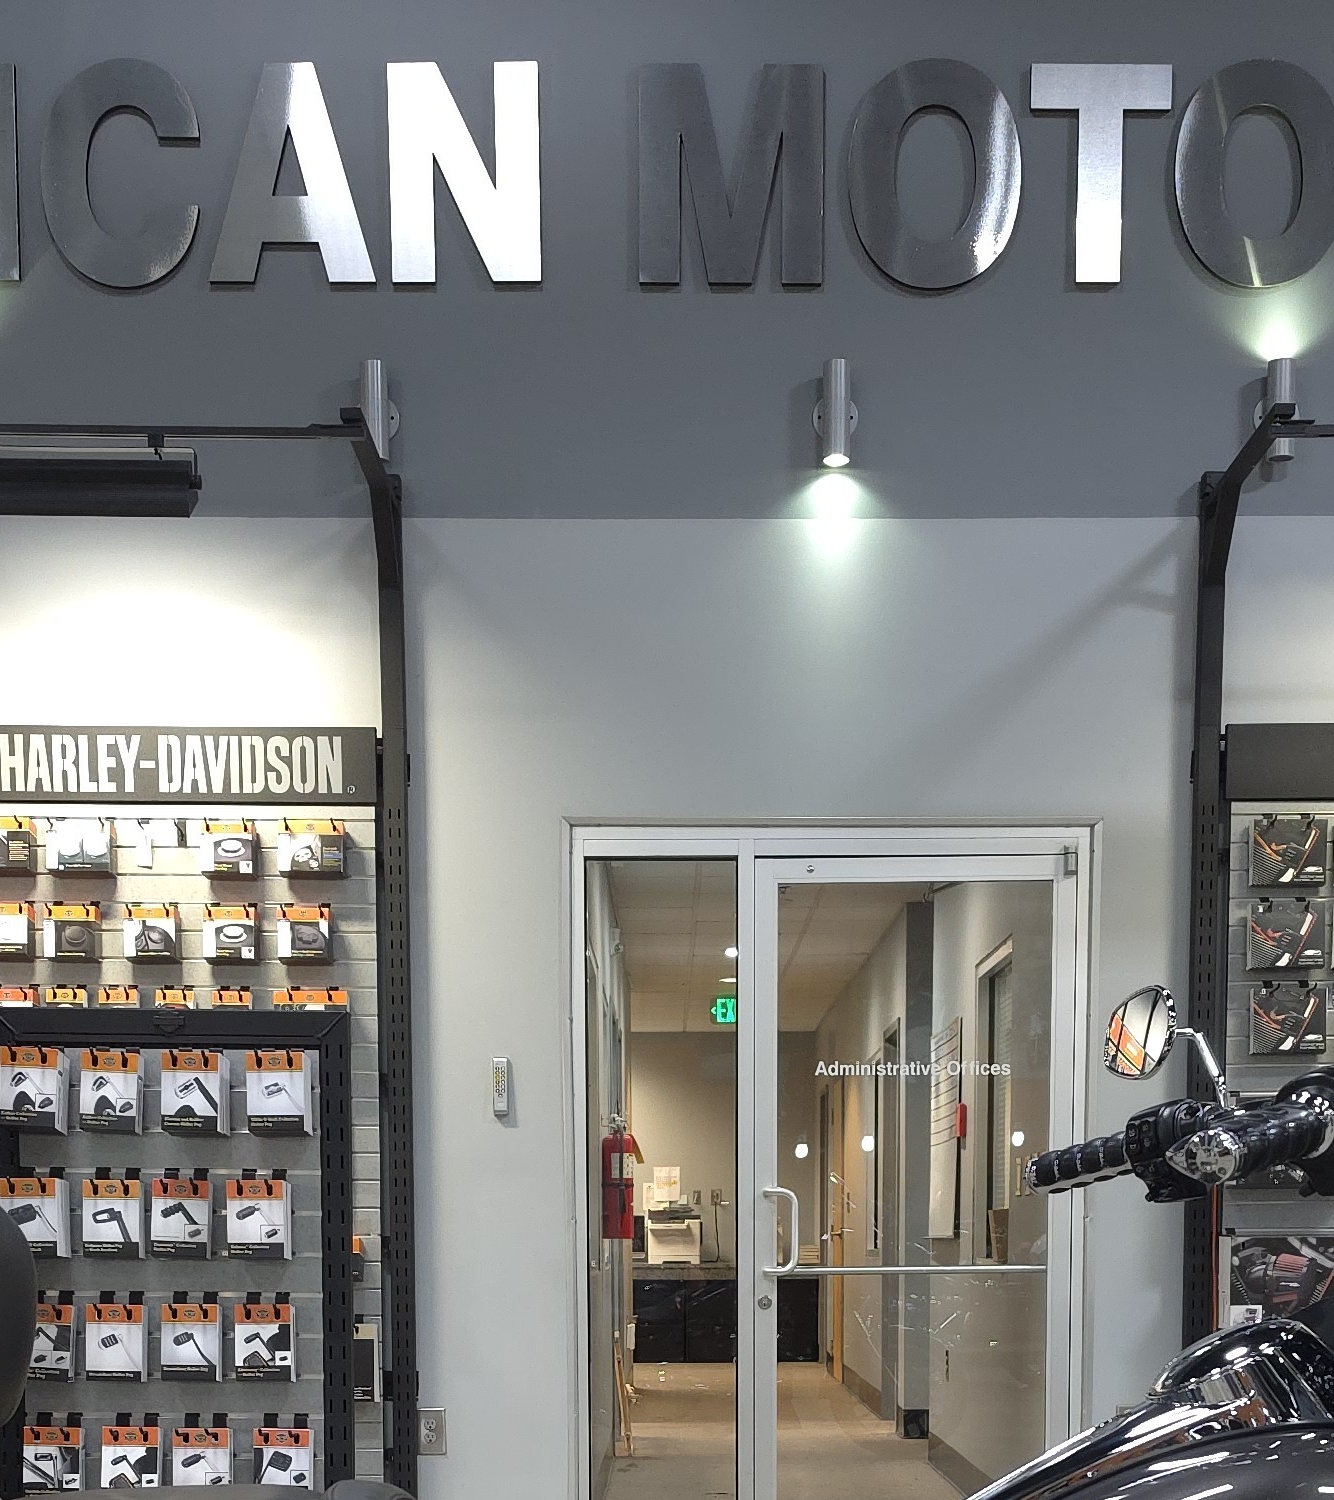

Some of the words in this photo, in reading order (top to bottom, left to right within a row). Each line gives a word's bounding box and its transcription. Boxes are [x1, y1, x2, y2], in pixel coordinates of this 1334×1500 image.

[0, 733, 346, 794] HARLEY-DAVIDSON
[716, 998, 736, 1022] EX
[814, 1060, 940, 1076] Administrative
[946, 1060, 1012, 1076] Offices
